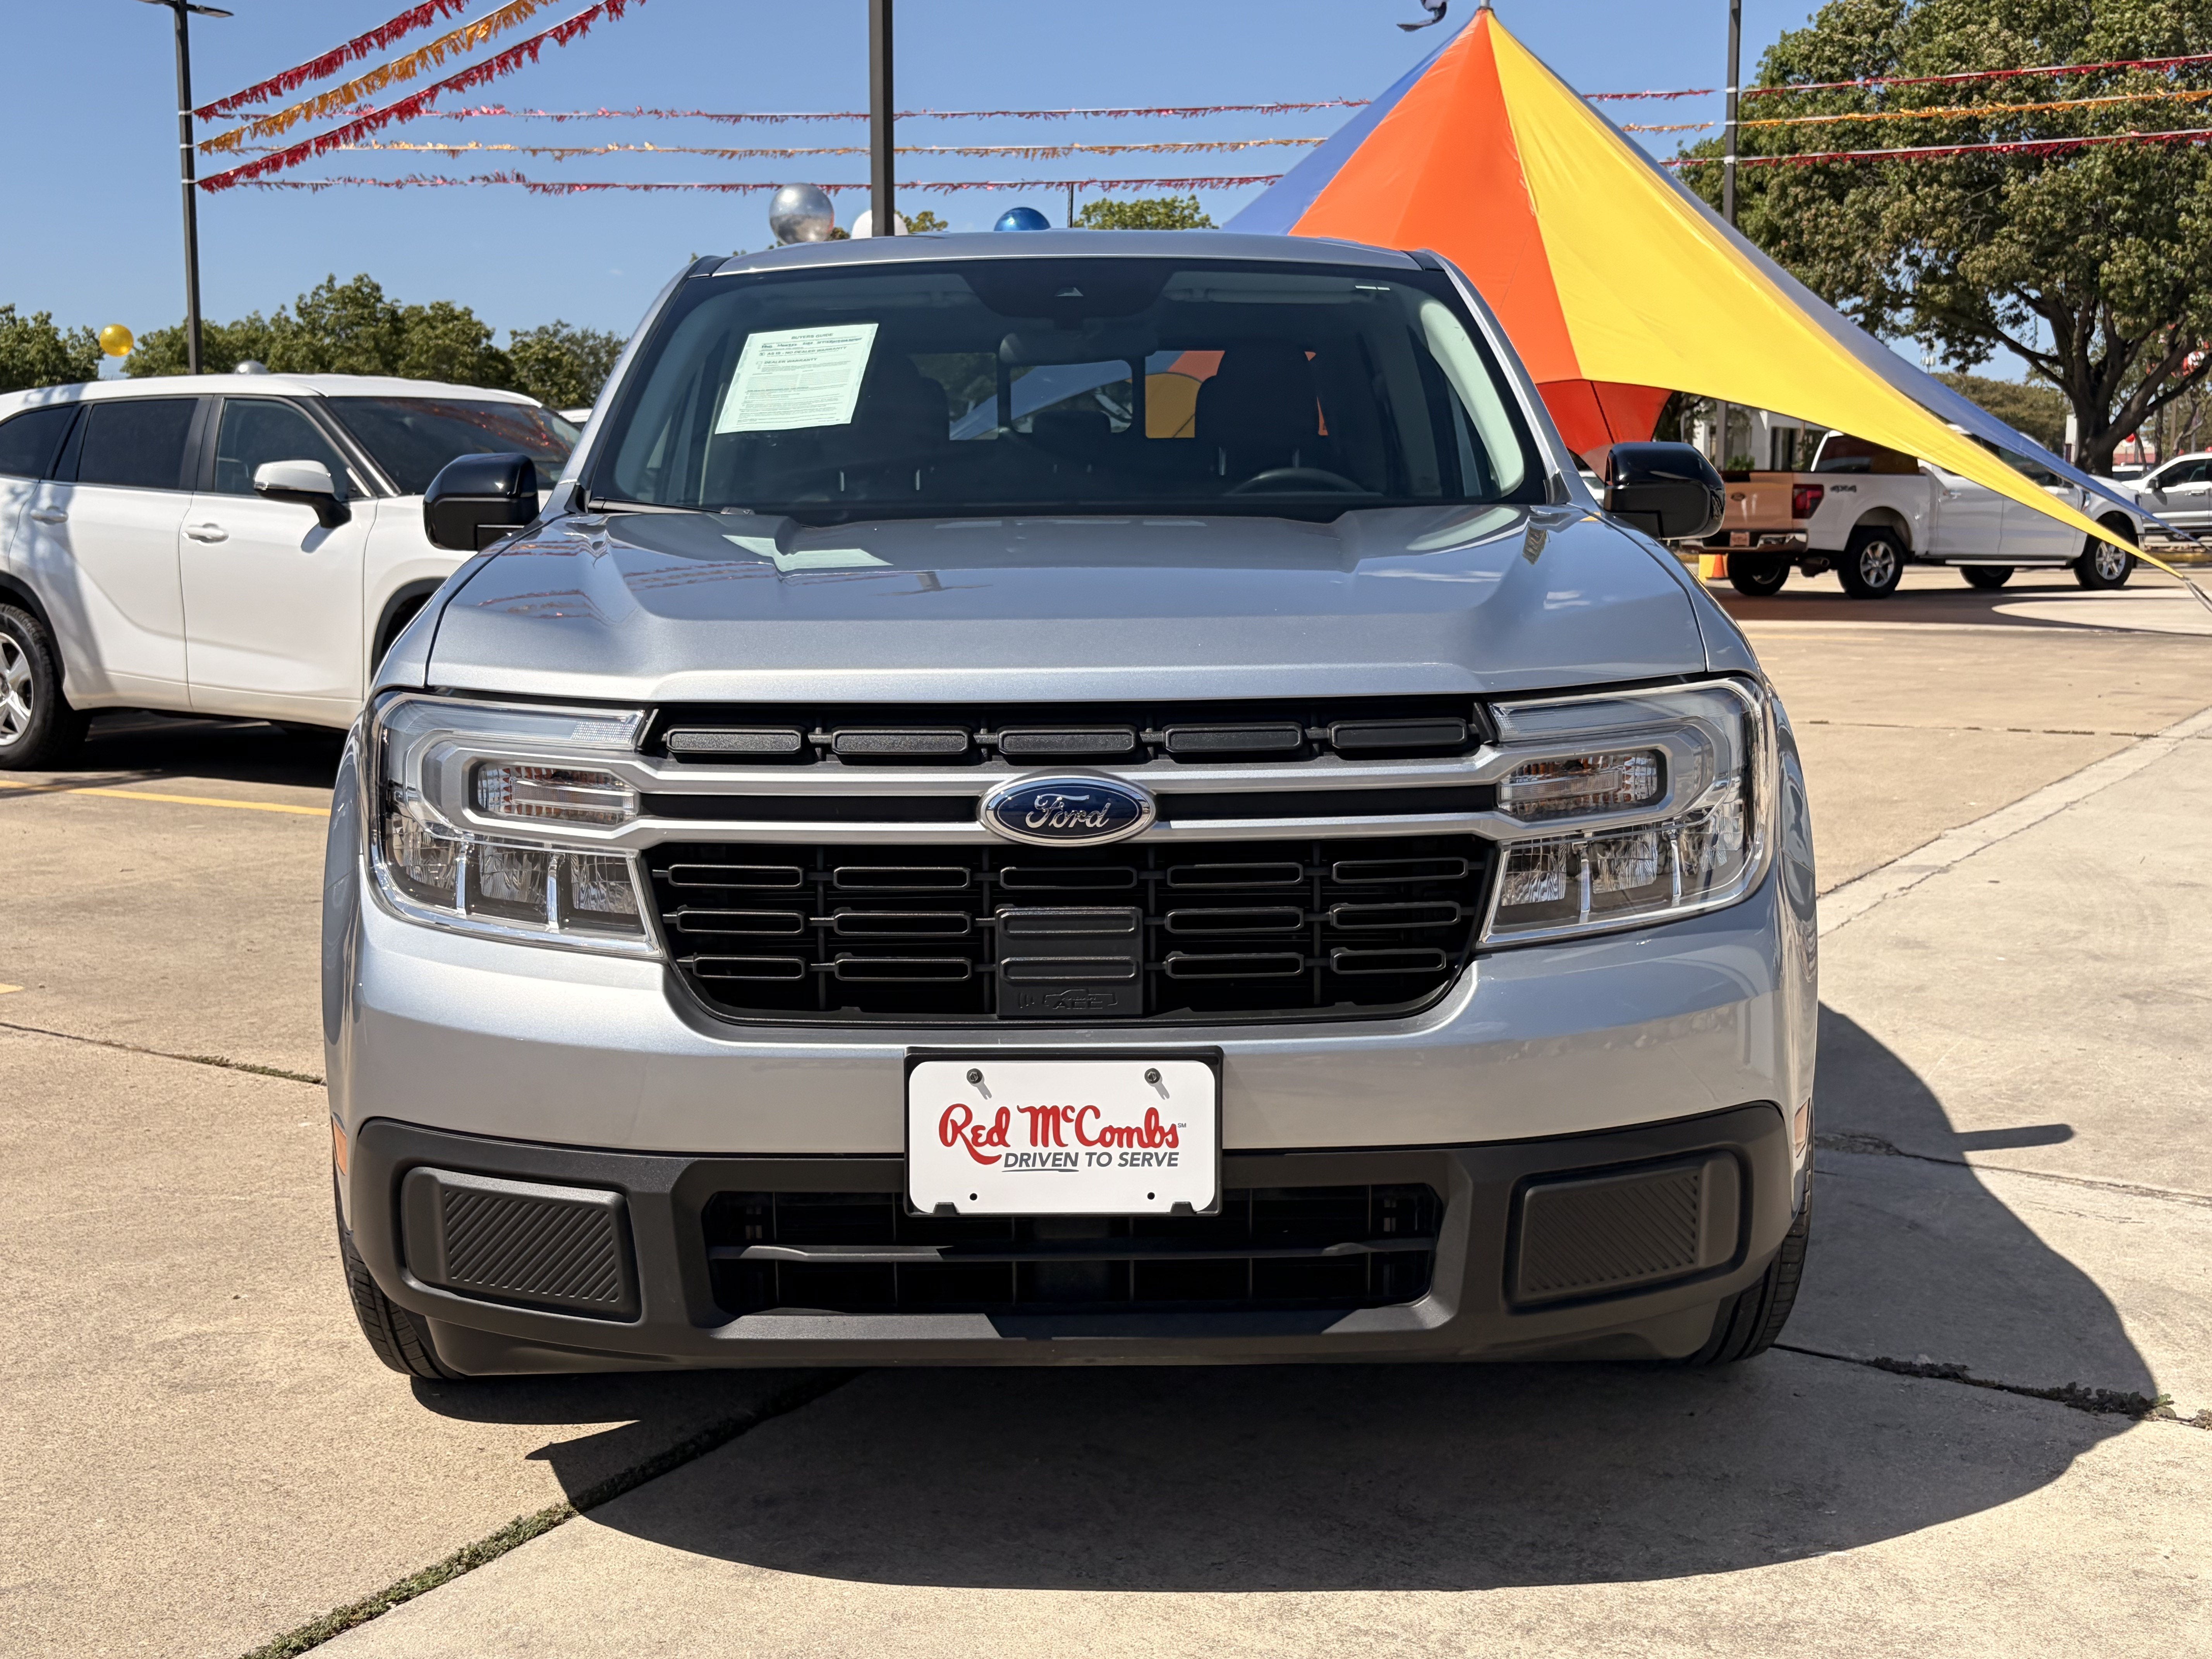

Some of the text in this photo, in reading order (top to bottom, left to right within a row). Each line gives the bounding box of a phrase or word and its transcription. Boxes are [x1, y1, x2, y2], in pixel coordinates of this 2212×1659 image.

[1025, 793, 1111, 828] Ford
[938, 1103, 1011, 1165] Red
[1017, 1104, 1179, 1149] McCombs
[1003, 1151, 1180, 1168] DRIVEN TO SERVE
